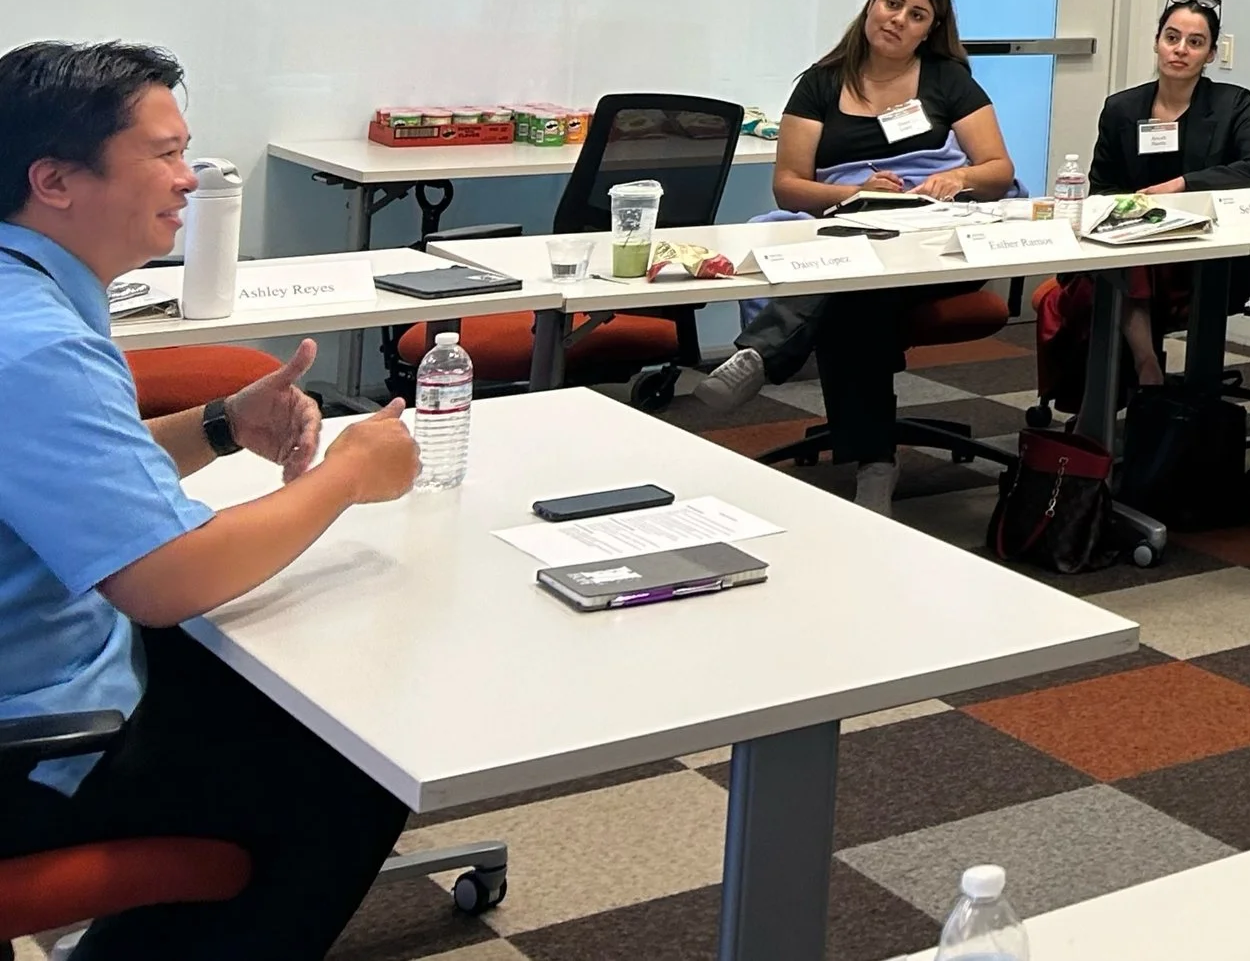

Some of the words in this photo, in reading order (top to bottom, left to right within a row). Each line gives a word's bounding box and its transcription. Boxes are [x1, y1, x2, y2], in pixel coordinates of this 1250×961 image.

[821, 256, 851, 270] Lopez
[238, 285, 288, 301] Ashley
[292, 283, 335, 297] Reyes
